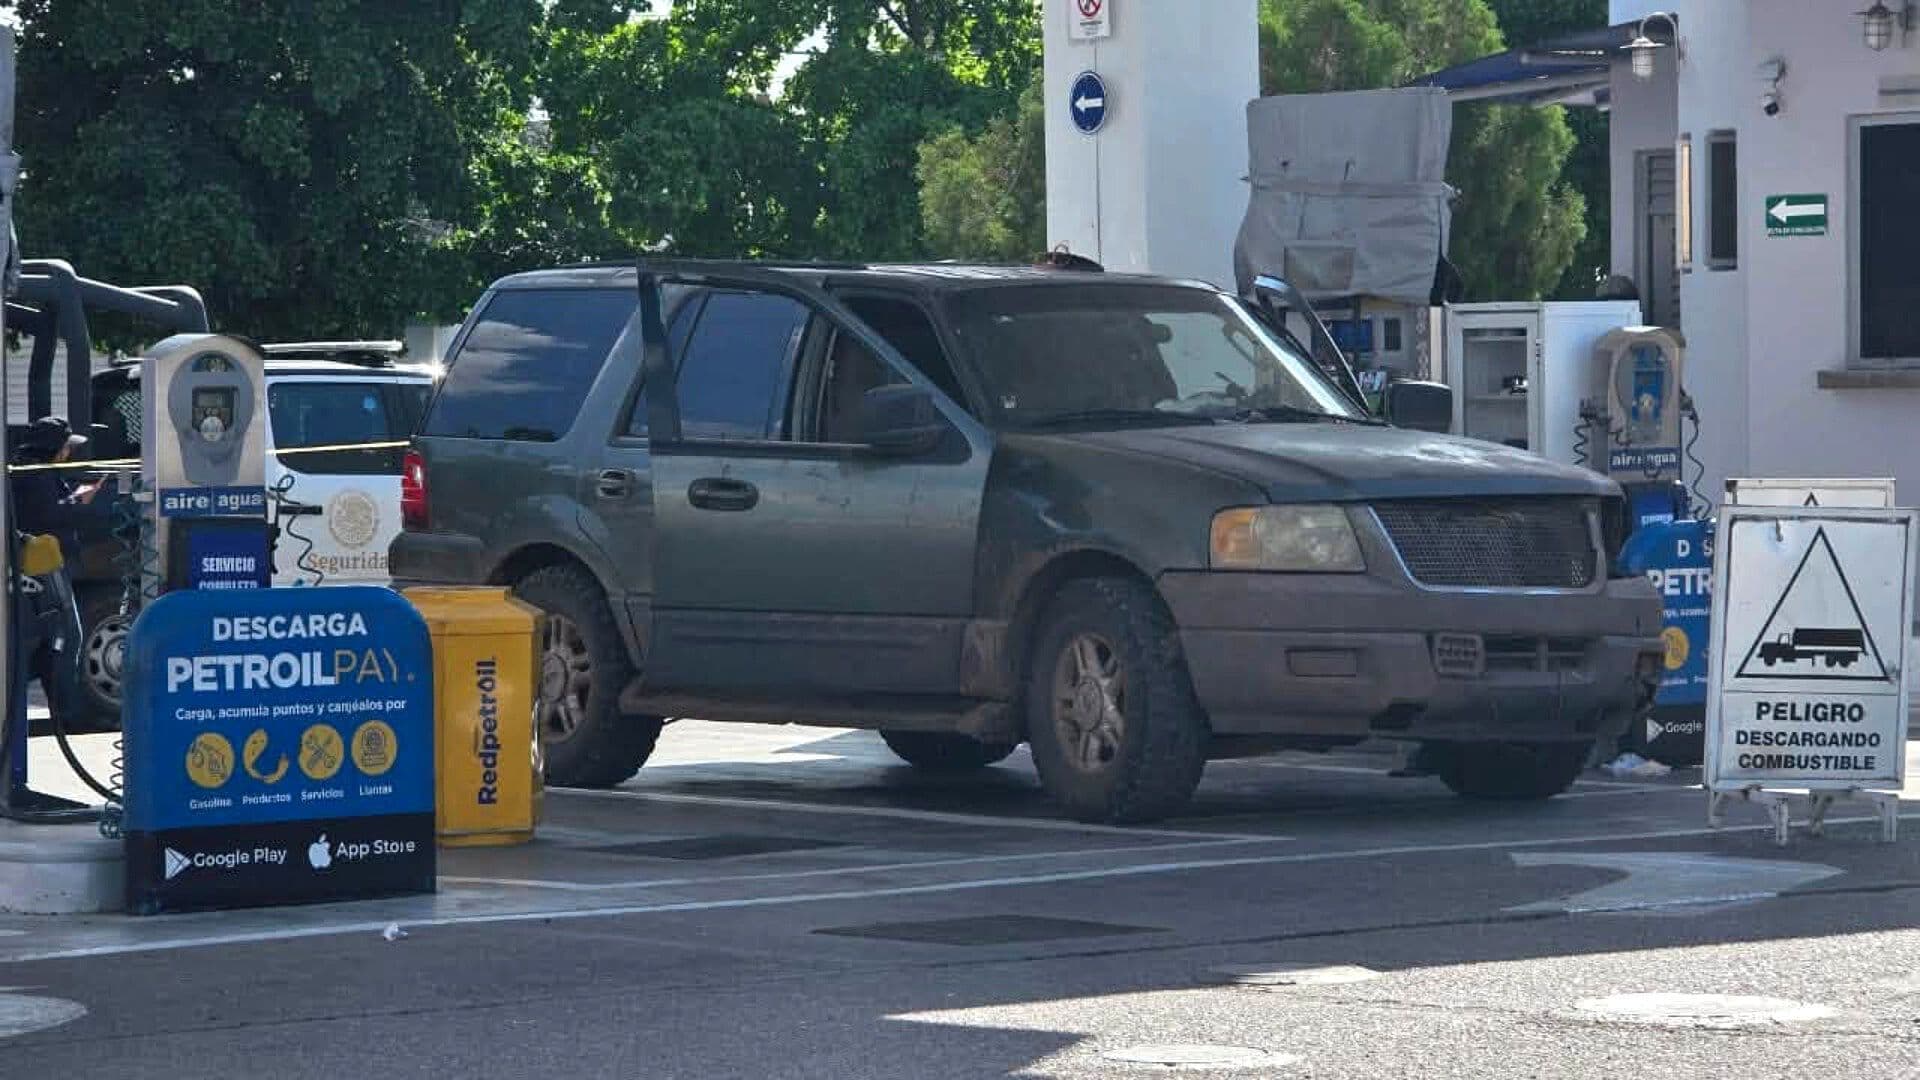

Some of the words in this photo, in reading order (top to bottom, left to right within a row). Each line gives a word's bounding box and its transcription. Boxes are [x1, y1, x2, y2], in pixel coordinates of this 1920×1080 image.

[164, 493, 209, 509] aire
[218, 494, 263, 511] agua
[201, 557, 256, 572] SERVICIO
[308, 551, 389, 574] Segurida
[1647, 567, 1713, 596] PETR
[212, 612, 368, 642] DESCARGA
[175, 707, 216, 722] Carga,
[218, 705, 270, 719] acumula
[273, 702, 314, 718] puntos
[317, 703, 325, 715] y
[328, 700, 384, 715] canjéalos
[385, 699, 407, 713] por
[1755, 701, 1864, 723] PELIGRO
[1665, 720, 1704, 734] Google
[1735, 729, 1881, 748] DESCARGANDO
[1738, 752, 1876, 771] COMBUSTIBLE
[242, 793, 292, 805] Productos
[301, 787, 344, 801] Servicios
[359, 784, 393, 796] Llantas
[189, 797, 233, 810] Gasolina
[193, 850, 250, 868] Google
[254, 847, 288, 865] Play
[336, 841, 370, 859] App
[373, 839, 416, 855] Store
